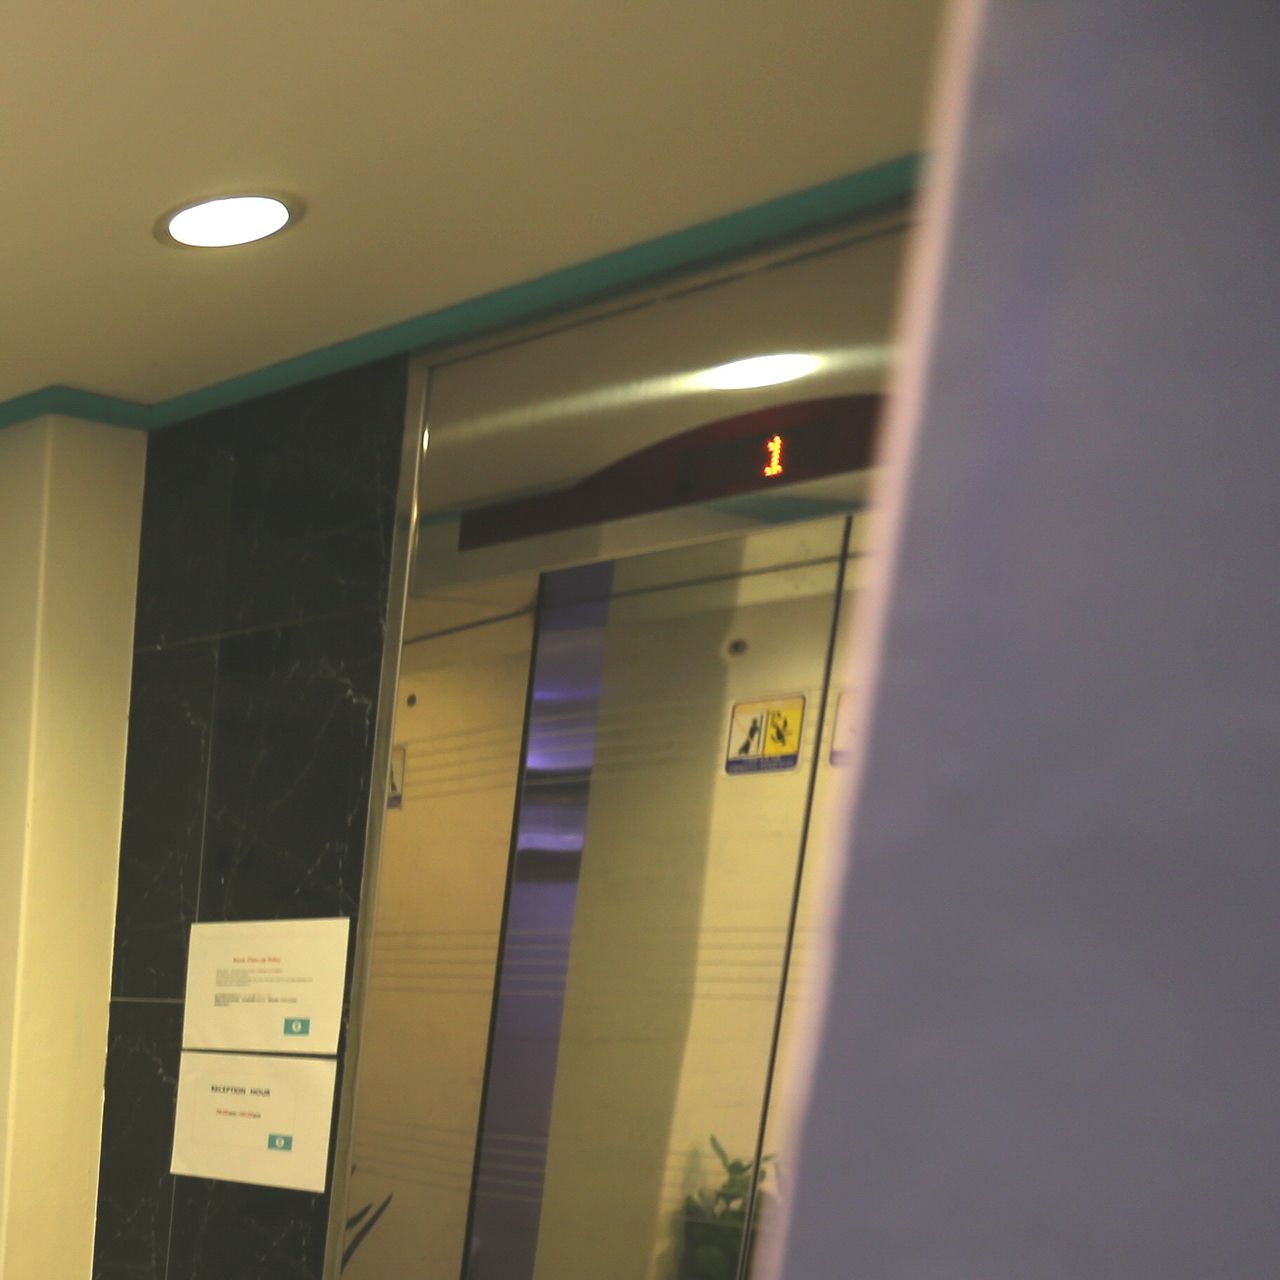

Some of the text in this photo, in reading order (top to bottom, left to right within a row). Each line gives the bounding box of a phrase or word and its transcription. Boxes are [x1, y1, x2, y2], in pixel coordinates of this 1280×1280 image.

[762, 434, 783, 477] 1
[210, 1085, 271, 1097] RECEPTION HOUR
